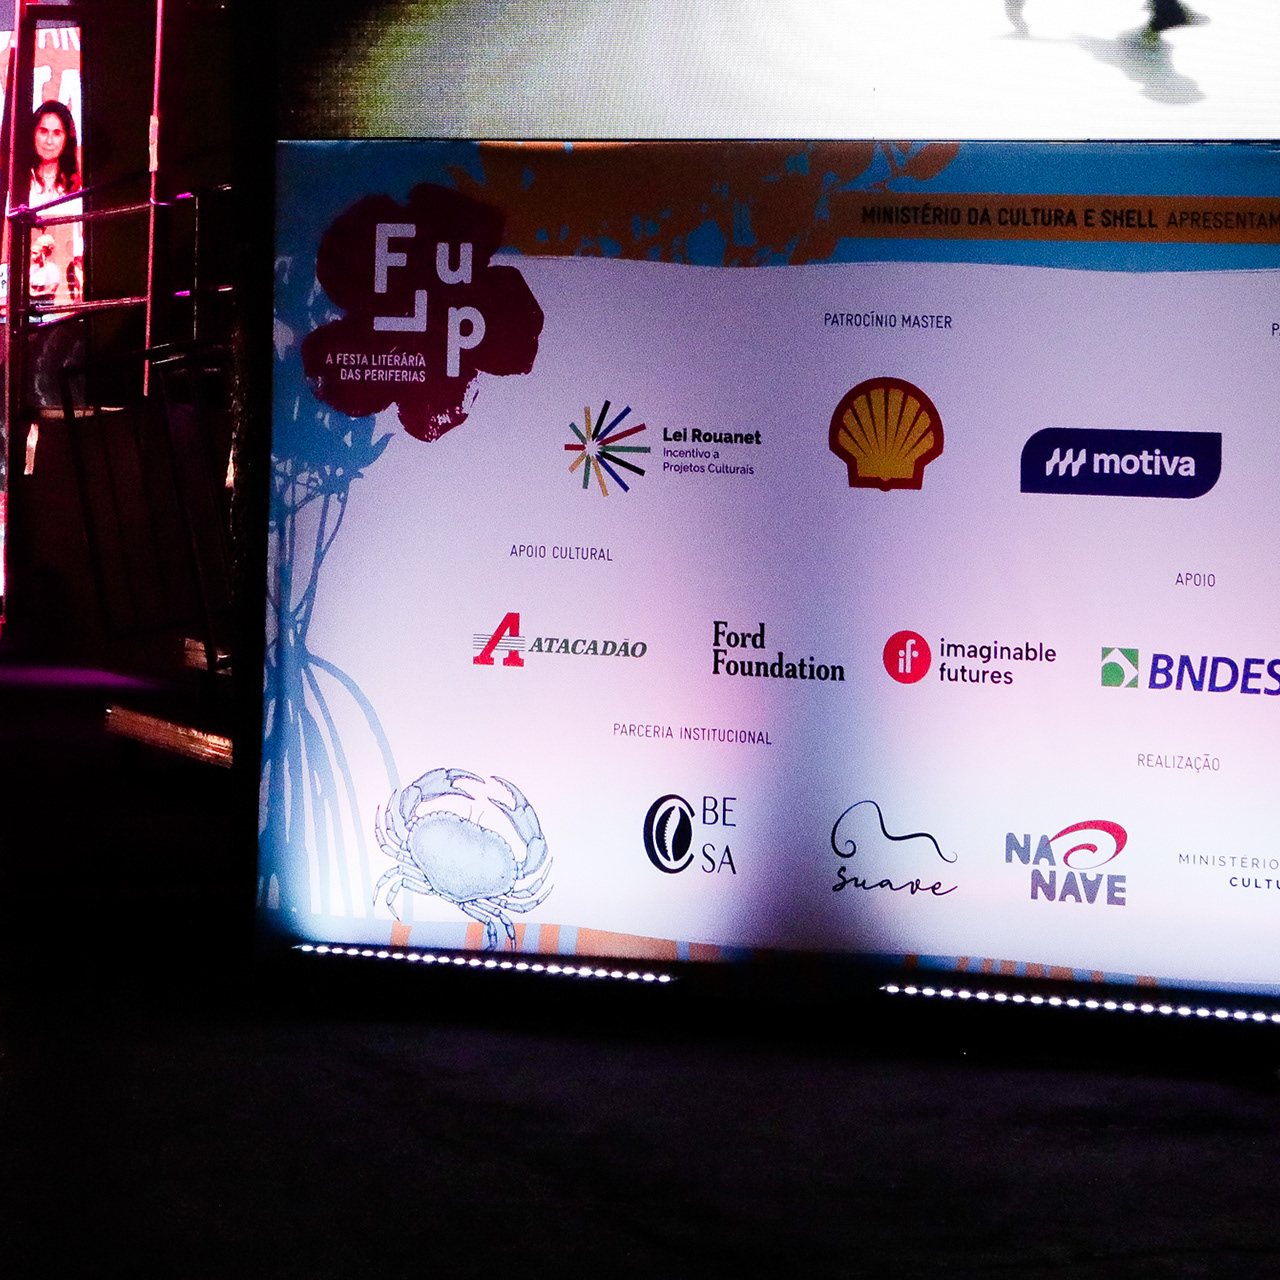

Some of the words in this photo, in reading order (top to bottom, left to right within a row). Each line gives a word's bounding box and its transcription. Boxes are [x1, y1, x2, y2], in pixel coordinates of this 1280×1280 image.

[861, 202, 961, 226] MINISTÉRIO
[967, 207, 992, 226] DA
[997, 208, 1078, 228] CULTURA
[1083, 209, 1096, 227] E
[1100, 210, 1158, 229] SHELL
[823, 311, 897, 328] PATROCÍNIO
[901, 315, 953, 330] MASTER
[325, 353, 333, 364] A
[336, 353, 368, 365] FESTA
[340, 368, 361, 380] DAS
[364, 369, 426, 383] PERIFERIAS
[663, 427, 687, 442] Lei
[691, 428, 762, 445] Rouanet
[663, 447, 711, 459] Incentivo
[712, 451, 720, 459] a
[1092, 448, 1197, 478] motiva
[663, 462, 706, 474] Projetos
[707, 463, 755, 475] Culturais
[509, 543, 547, 558] APOIO
[551, 546, 613, 562] CULTURAL
[1174, 572, 1216, 588] APOIO
[712, 620, 766, 650] Ford
[527, 636, 648, 659] ATACADÃO
[939, 637, 1057, 664] imaginable
[712, 649, 845, 681] Foundation
[939, 662, 1014, 685] futures
[613, 723, 674, 740] PARCERIA
[679, 727, 773, 746] INSTITUCIONAL
[1137, 753, 1220, 773] REALIZAÇÃO
[1005, 832, 1056, 866] NA
[1178, 854, 1280, 871] MINISTÉRIO
[1031, 869, 1127, 906] NAVE
